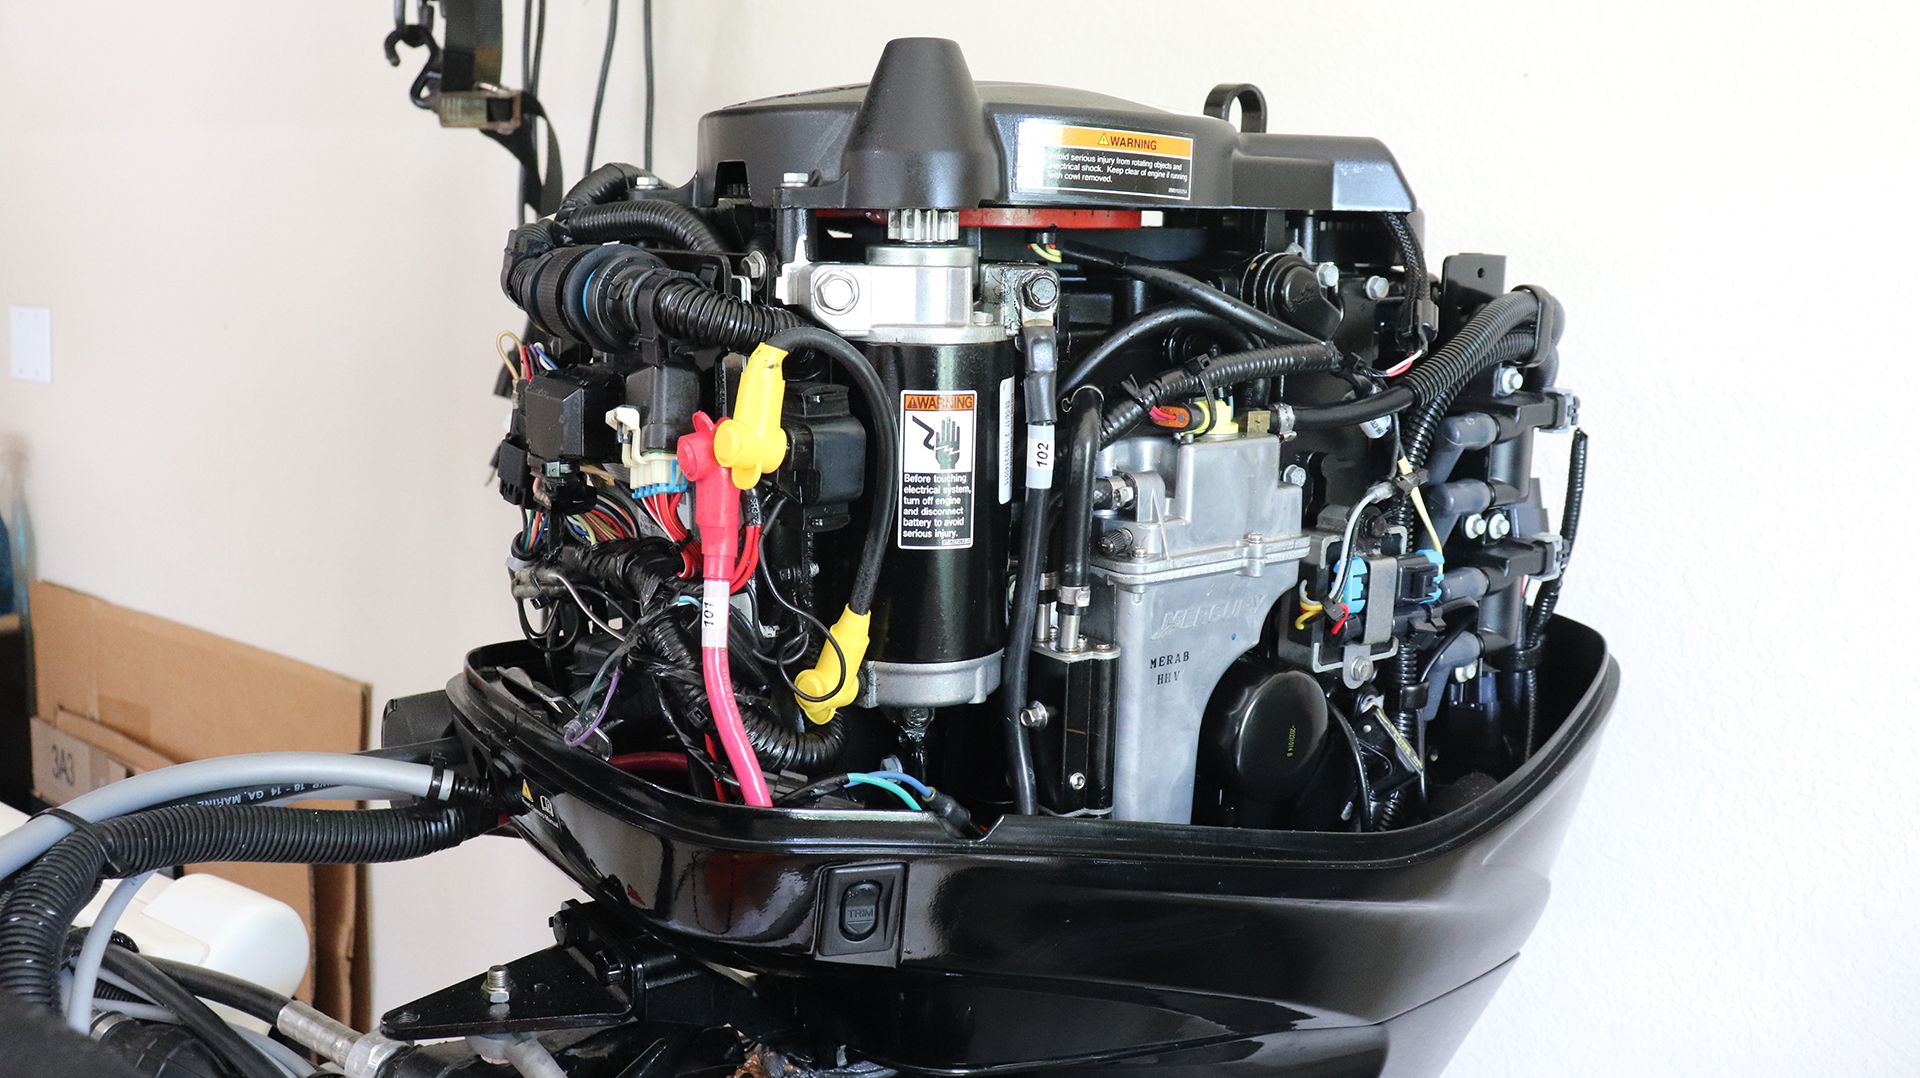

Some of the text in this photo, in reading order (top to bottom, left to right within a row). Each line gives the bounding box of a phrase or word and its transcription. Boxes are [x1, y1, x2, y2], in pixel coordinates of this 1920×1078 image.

[1110, 136, 1157, 150] WARNING
[1070, 153, 1096, 163] serious
[1097, 152, 1115, 166] injury
[1116, 157, 1130, 165] from
[1131, 159, 1153, 169] rotating
[1153, 161, 1172, 170] objects
[1081, 164, 1103, 172] shock.
[1107, 166, 1124, 175] Keep
[1147, 170, 1165, 179] engine
[1170, 173, 1188, 182] running
[1081, 174, 1113, 182] removed.
[917, 396, 972, 409] WARNING
[1036, 442, 1049, 467] 102
[903, 473, 967, 484] Before touching
[903, 485, 972, 495] electrical system,
[903, 496, 961, 506] turn off engine
[903, 506, 964, 515] and disconnect
[903, 517, 965, 529] battery to avoid
[902, 528, 958, 540] serious injury.
[703, 601, 714, 627] 101
[1150, 651, 1189, 669] MERAB
[271, 786, 282, 796] 14
[294, 783, 304, 791] 18
[244, 789, 263, 800] GA.
[848, 908, 873, 918] TRIM
